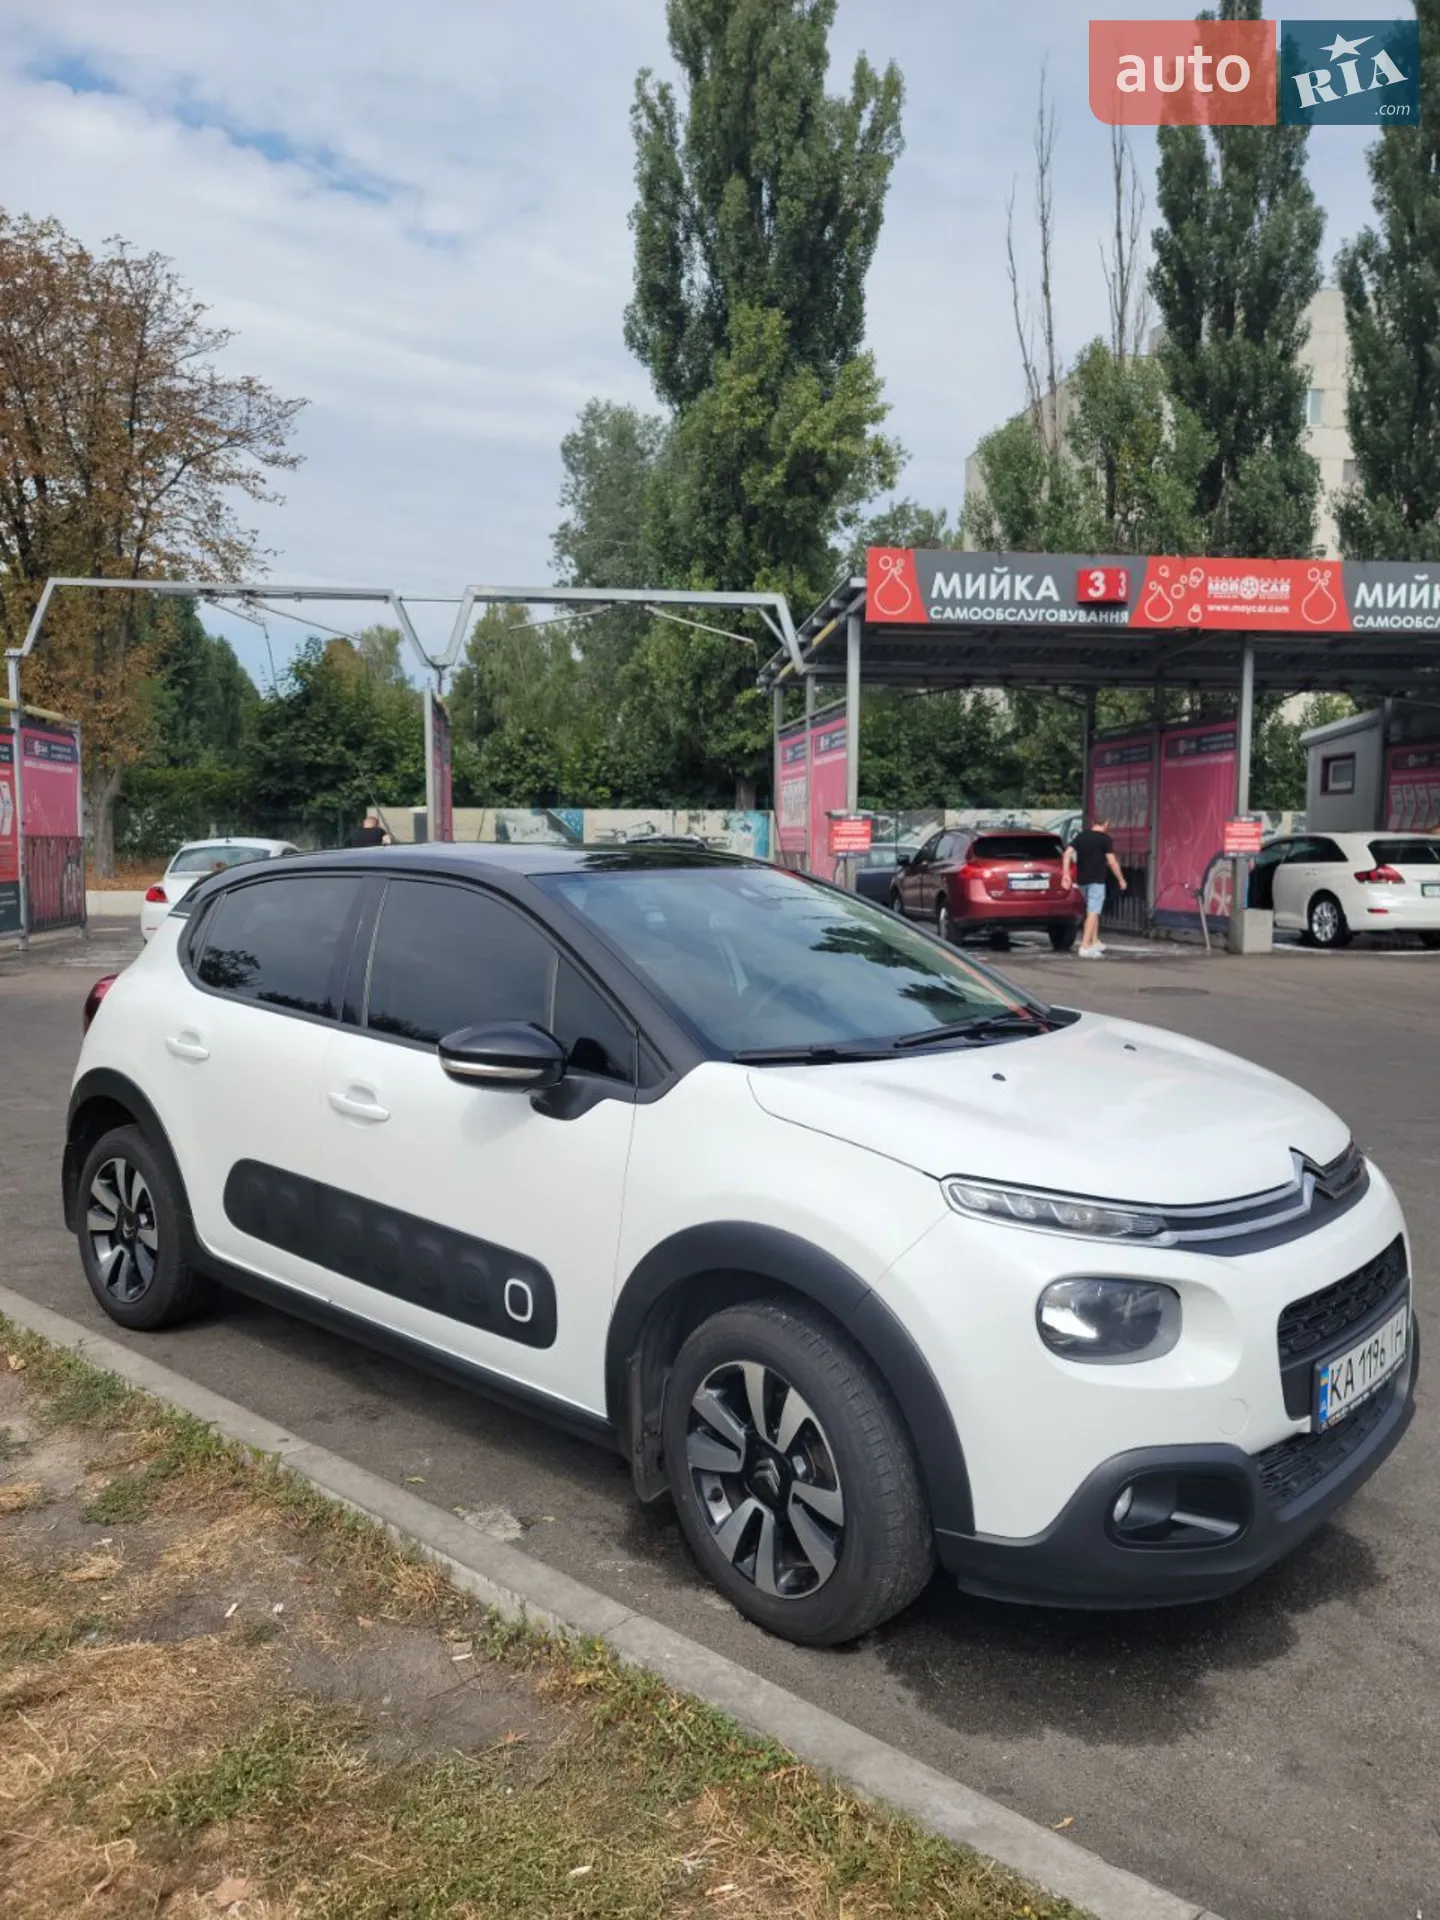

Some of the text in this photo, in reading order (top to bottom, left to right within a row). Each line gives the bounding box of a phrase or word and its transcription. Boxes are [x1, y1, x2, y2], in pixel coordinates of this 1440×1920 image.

[931, 566, 1060, 601] МИЙКА
[1087, 570, 1106, 598] 3
[929, 605, 1129, 624] САМООБСЛУГОВУВАННЯ
